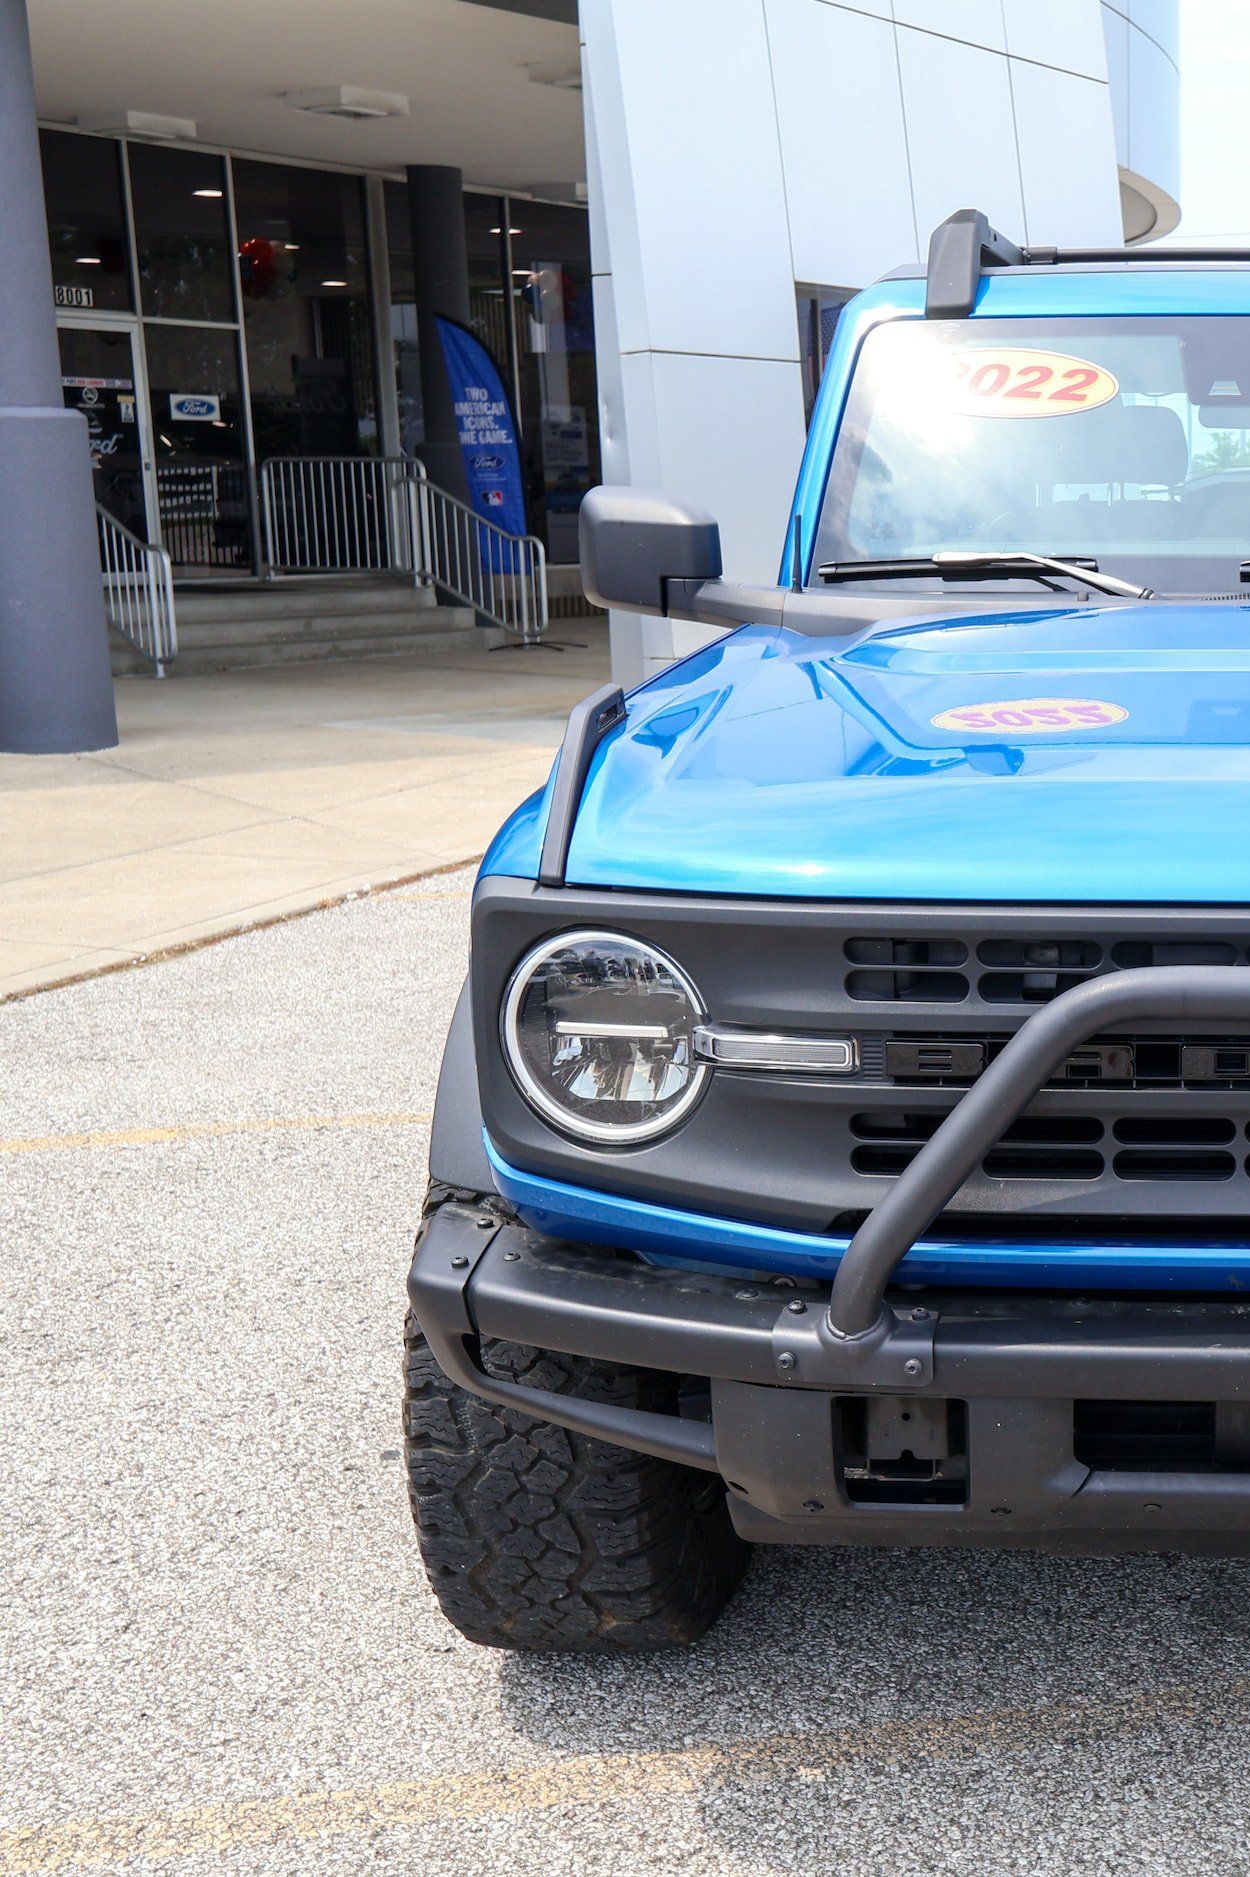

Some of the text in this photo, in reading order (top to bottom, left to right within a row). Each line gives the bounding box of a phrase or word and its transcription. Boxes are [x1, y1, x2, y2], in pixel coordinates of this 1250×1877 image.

[58, 287, 91, 306] 8001
[464, 387, 488, 401] TWO
[455, 402, 506, 416] AMERICAN
[474, 455, 498, 468] Ford
